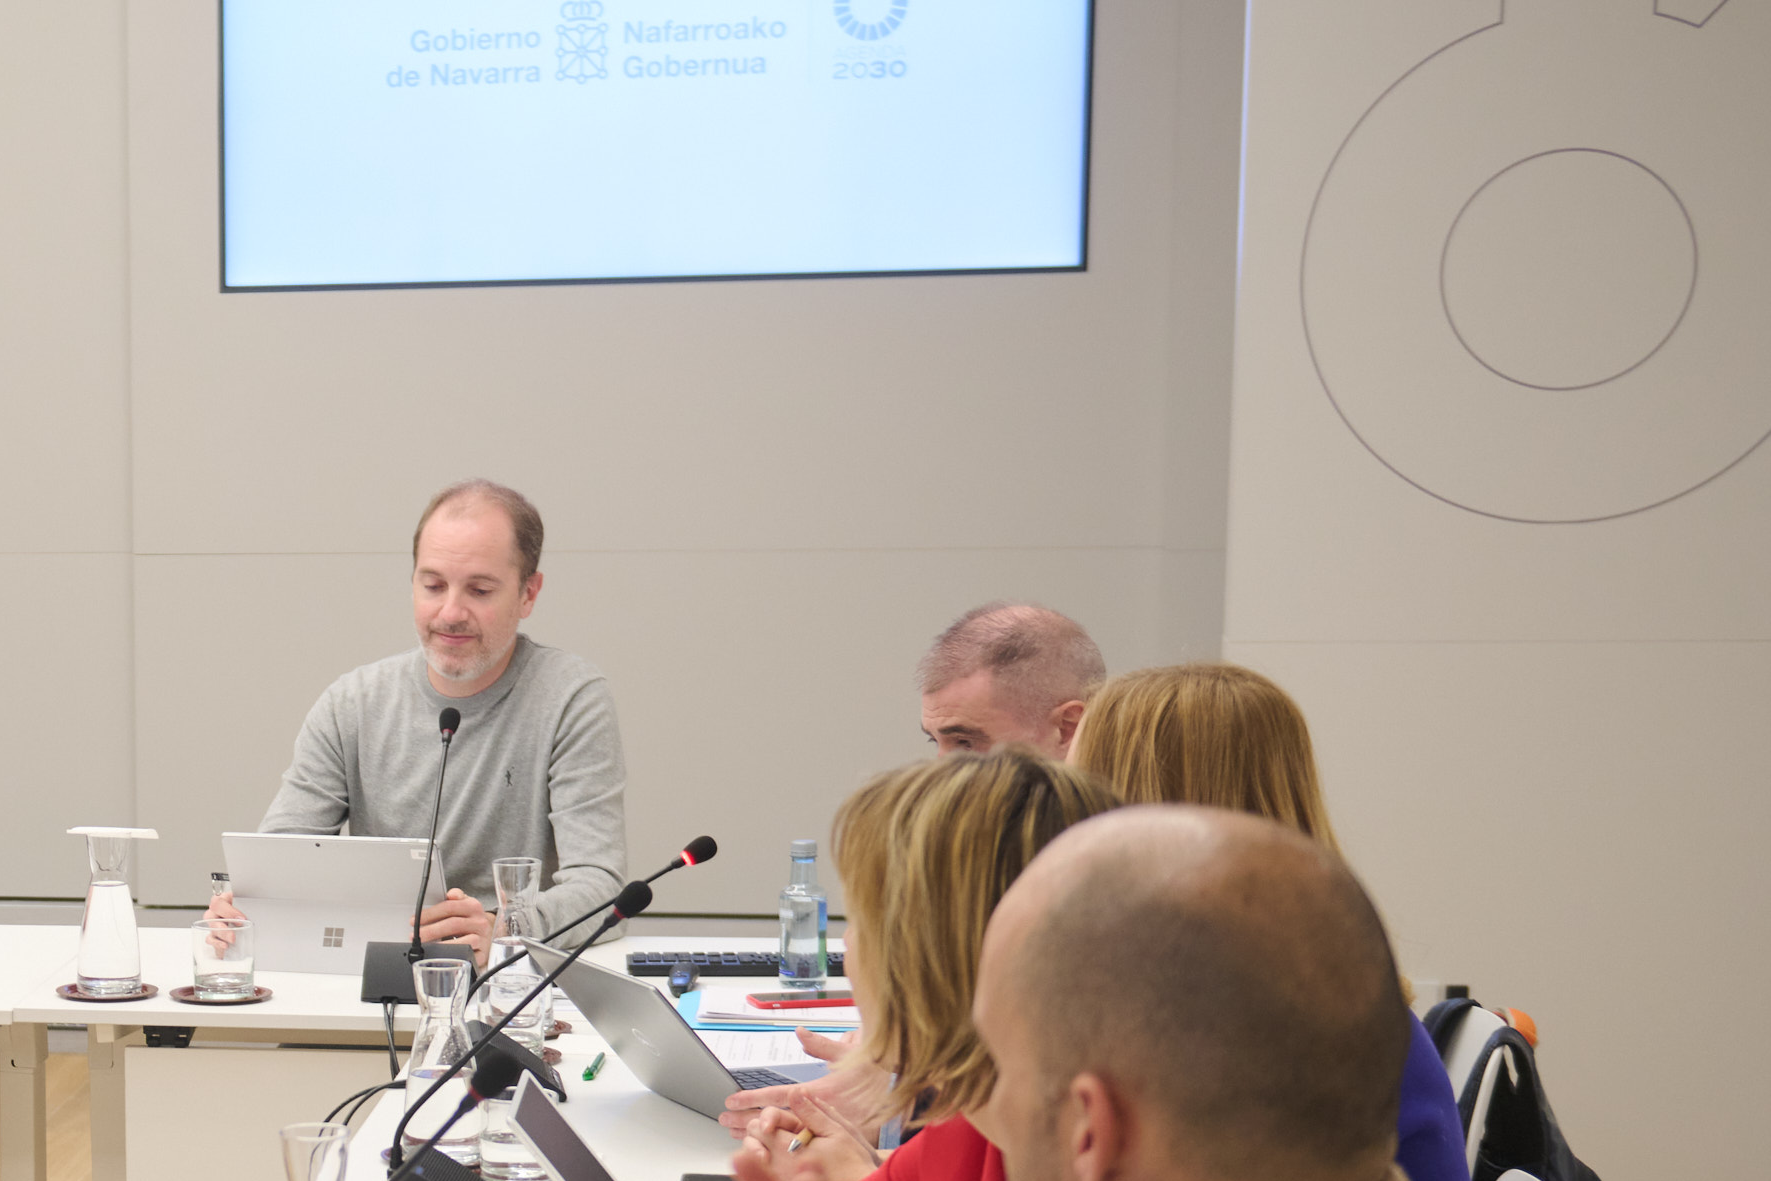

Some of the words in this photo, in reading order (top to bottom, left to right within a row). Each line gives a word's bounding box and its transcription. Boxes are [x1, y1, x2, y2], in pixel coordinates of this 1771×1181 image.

[410, 28, 541, 53] Gobierno
[623, 16, 788, 44] Nafarroako
[386, 65, 421, 88] de
[430, 63, 541, 86] Navarra
[623, 55, 768, 79] Gobernua
[831, 60, 908, 79] 2030
